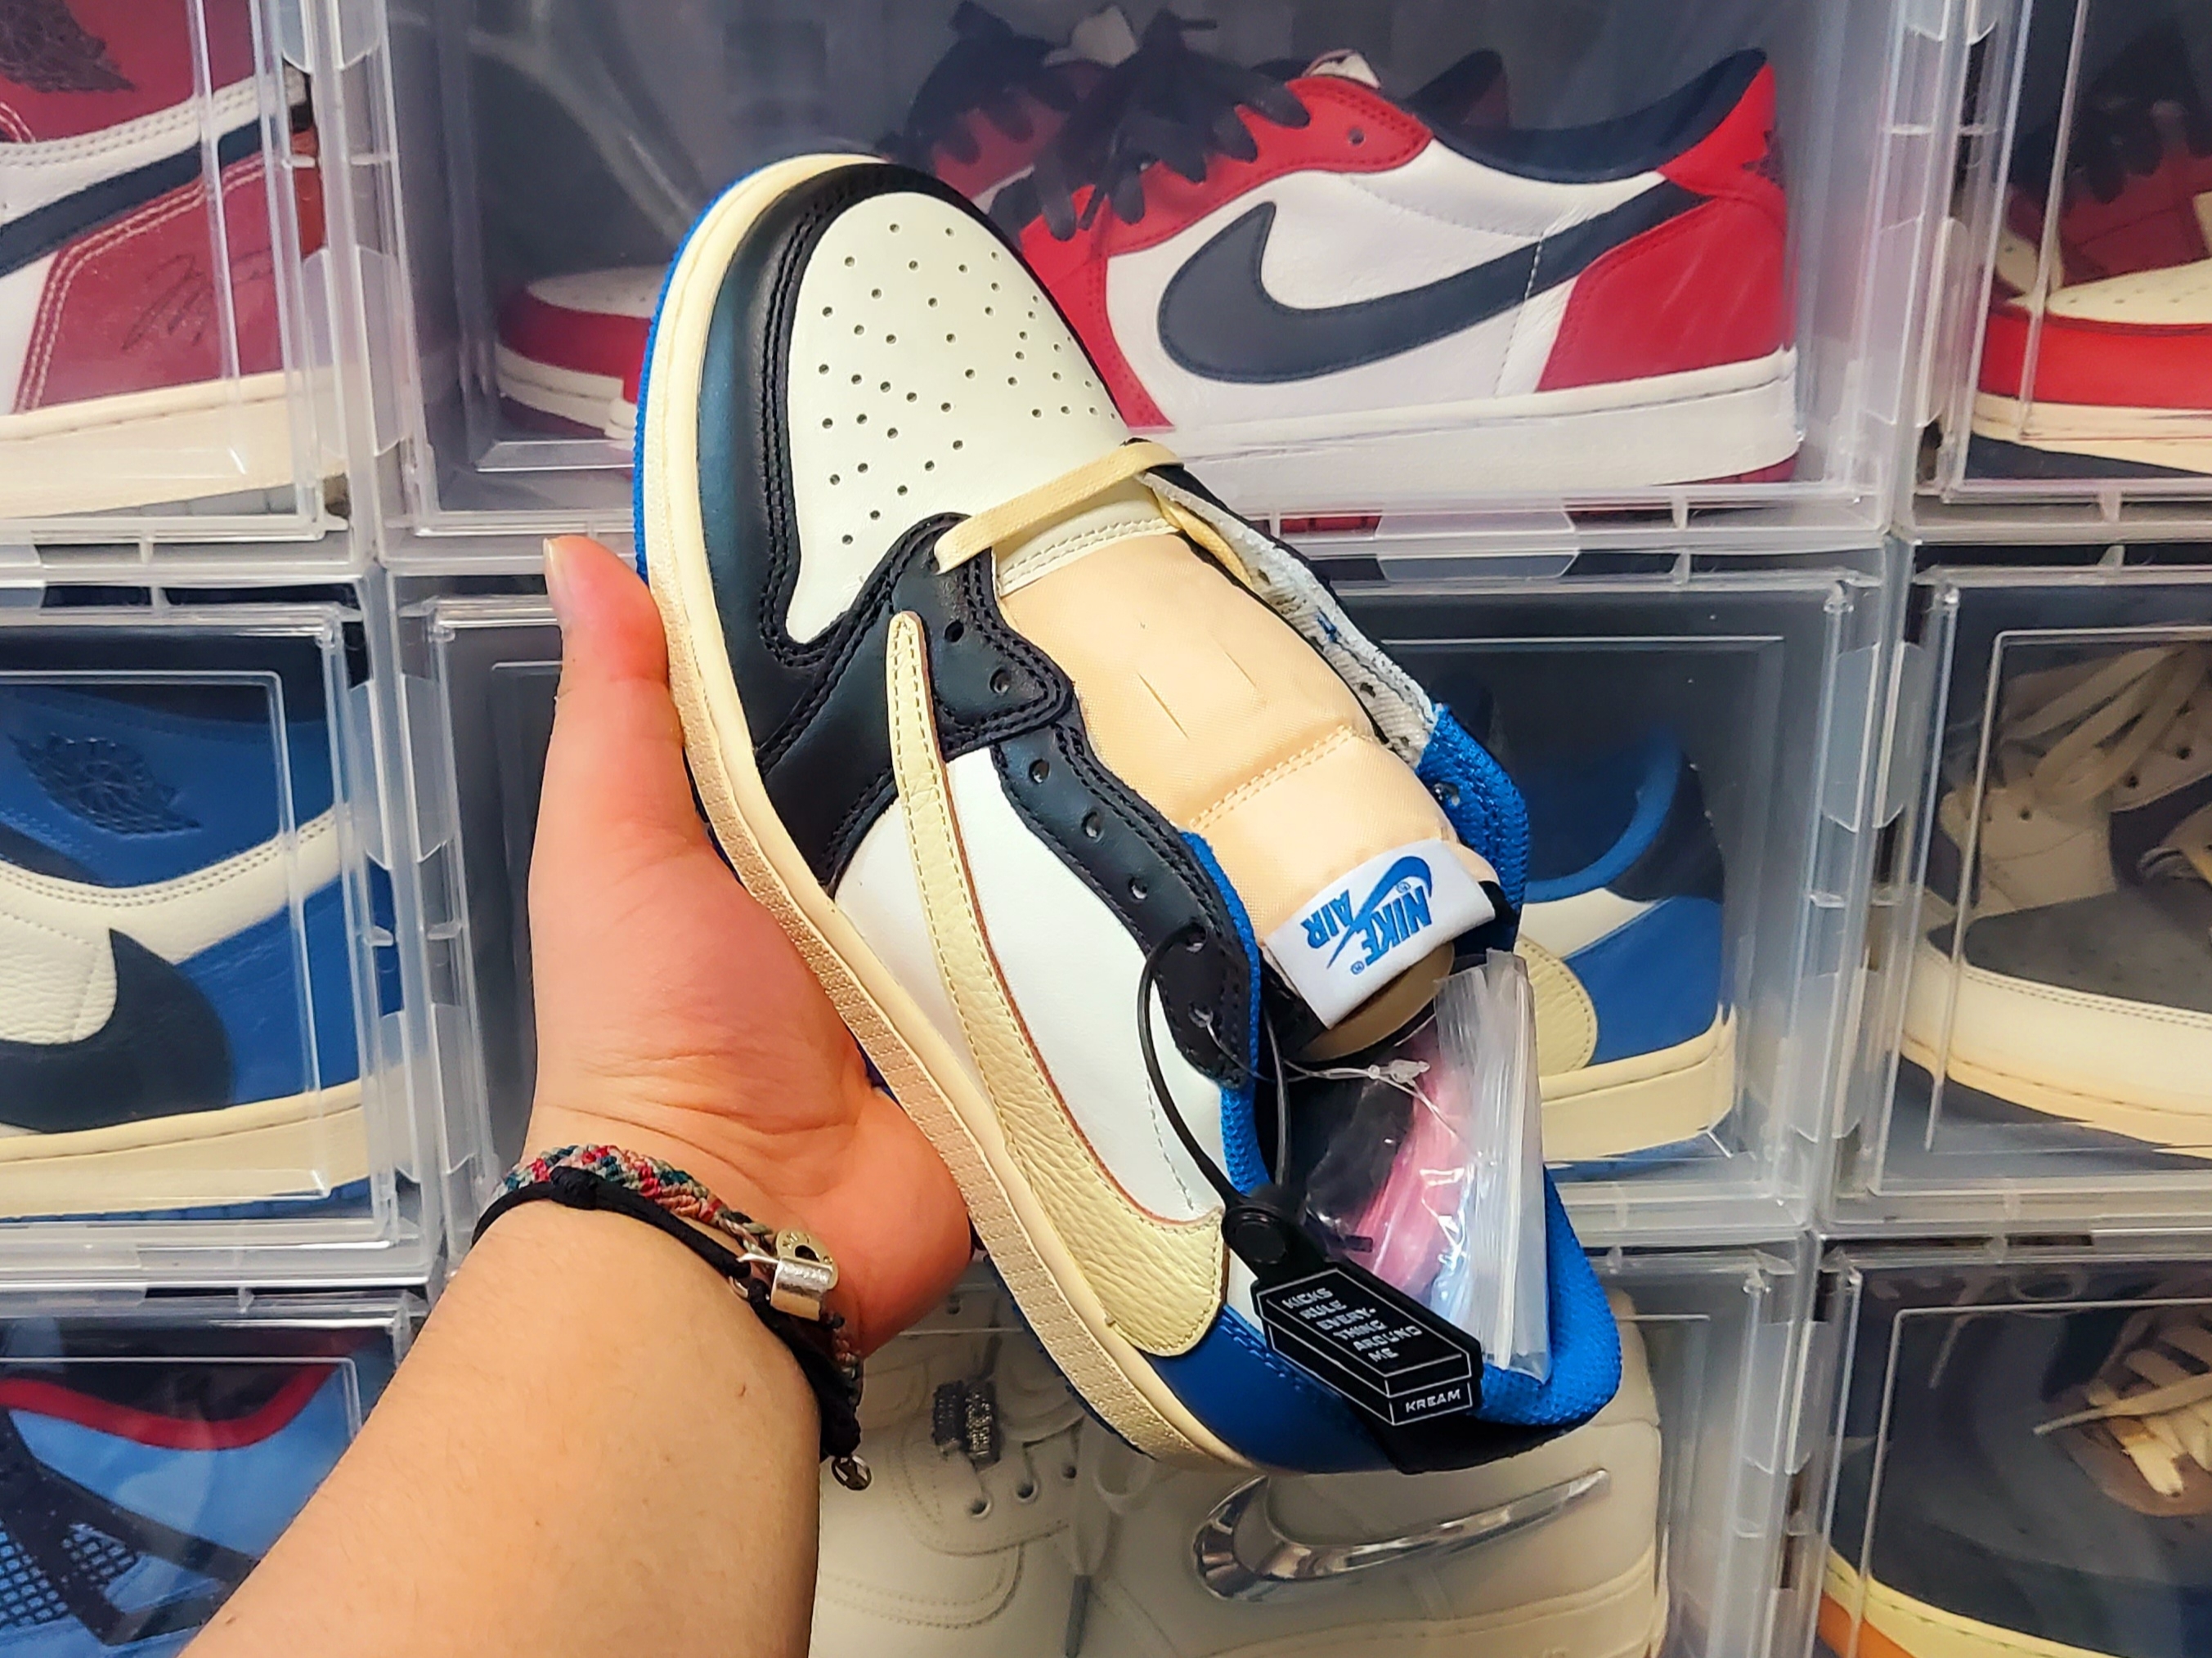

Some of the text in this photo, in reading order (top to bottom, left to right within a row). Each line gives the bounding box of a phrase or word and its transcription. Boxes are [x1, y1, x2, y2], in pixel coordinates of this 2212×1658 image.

[1300, 889, 1353, 949] AIR
[1357, 885, 1432, 966] NIKE
[1281, 1288, 1334, 1309] KICKS
[1299, 1300, 1348, 1320] RULE
[1333, 1320, 1388, 1340] THING
[1353, 1325, 1423, 1351] AROUND
[1368, 1347, 1399, 1362] ME
[1406, 1388, 1461, 1413] KREAM
